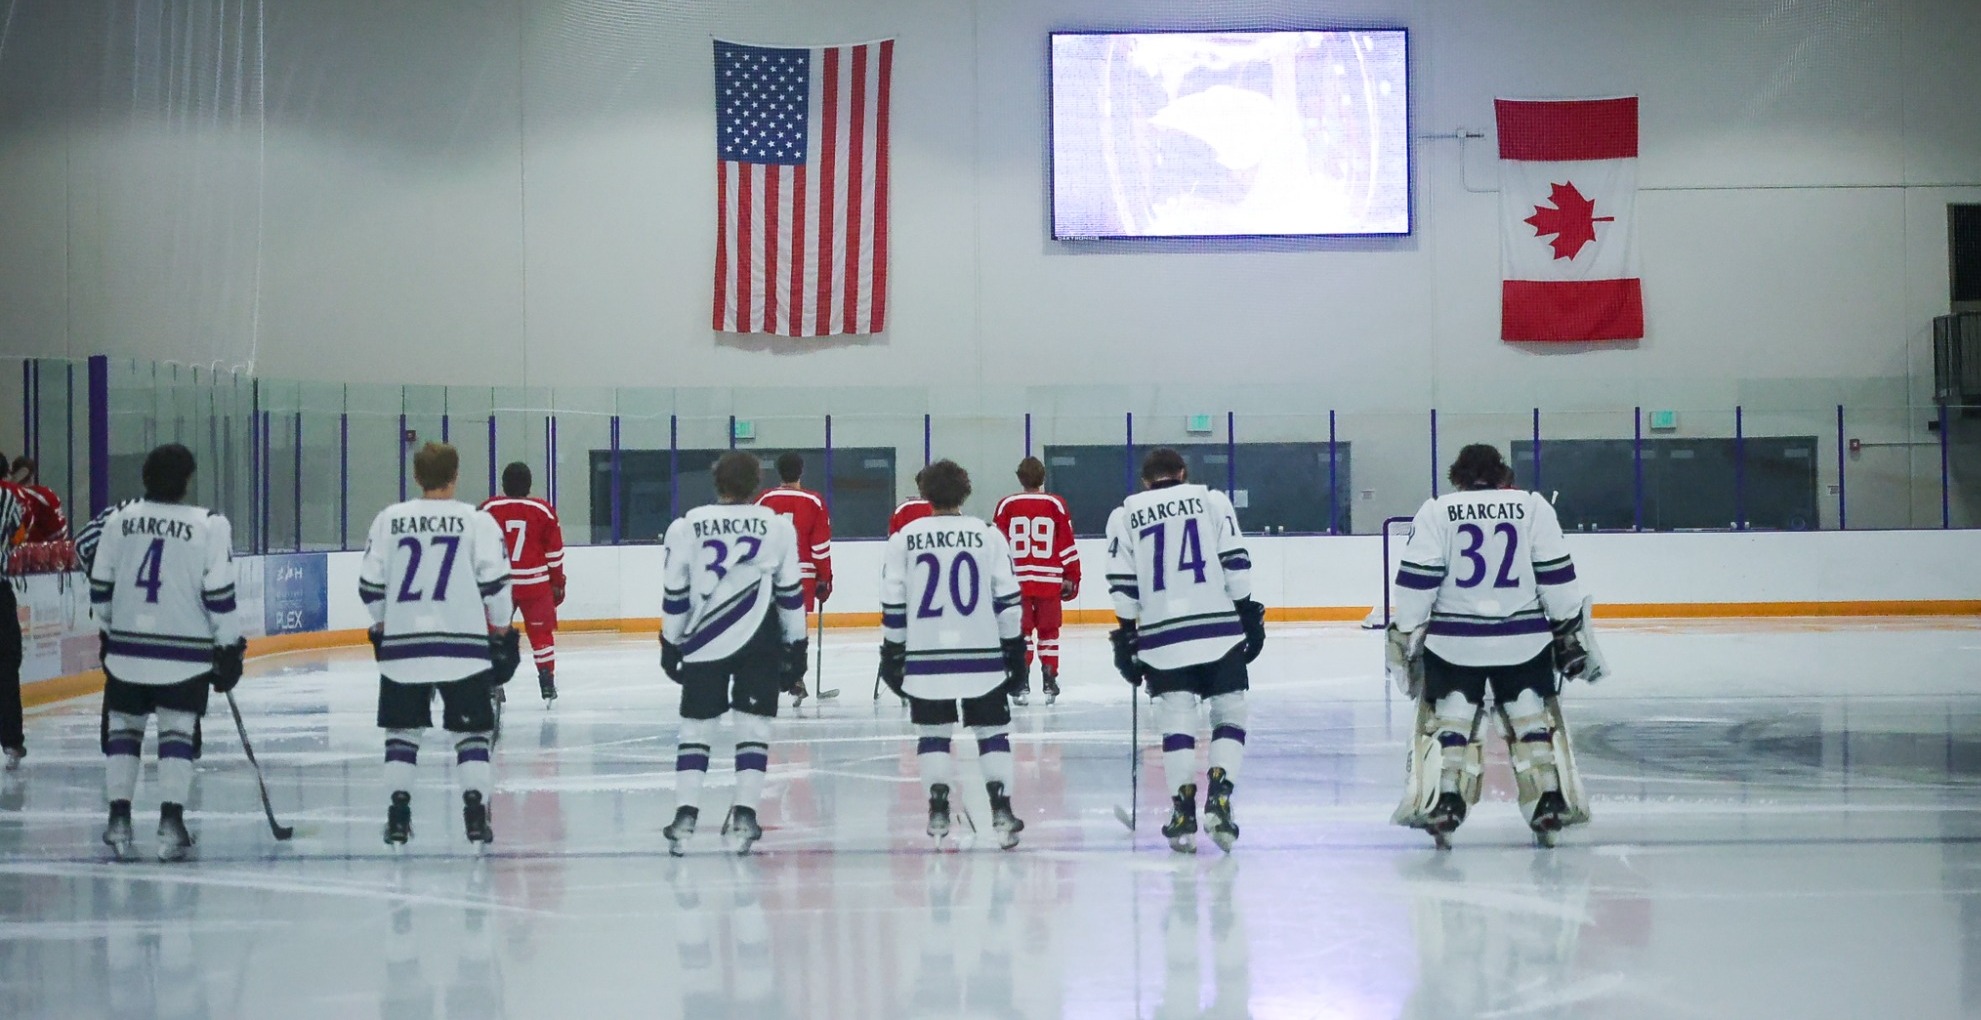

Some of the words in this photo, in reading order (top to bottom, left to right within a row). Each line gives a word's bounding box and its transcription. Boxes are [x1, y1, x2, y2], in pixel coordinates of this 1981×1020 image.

[121, 516, 194, 541] BEARCATS
[391, 516, 465, 534] BEARCATS
[693, 518, 768, 538] BEARCATS
[1130, 498, 1204, 529] BEARCATS
[1447, 502, 1525, 521] BEARCATS
[505, 519, 527, 562] 7
[907, 531, 983, 550] BEARCATS
[1008, 516, 1055, 559] 89
[1139, 517, 1207, 592] 74
[1455, 522, 1520, 588] 32
[135, 537, 166, 603] 4
[397, 536, 460, 603] 27
[916, 551, 979, 619] 20
